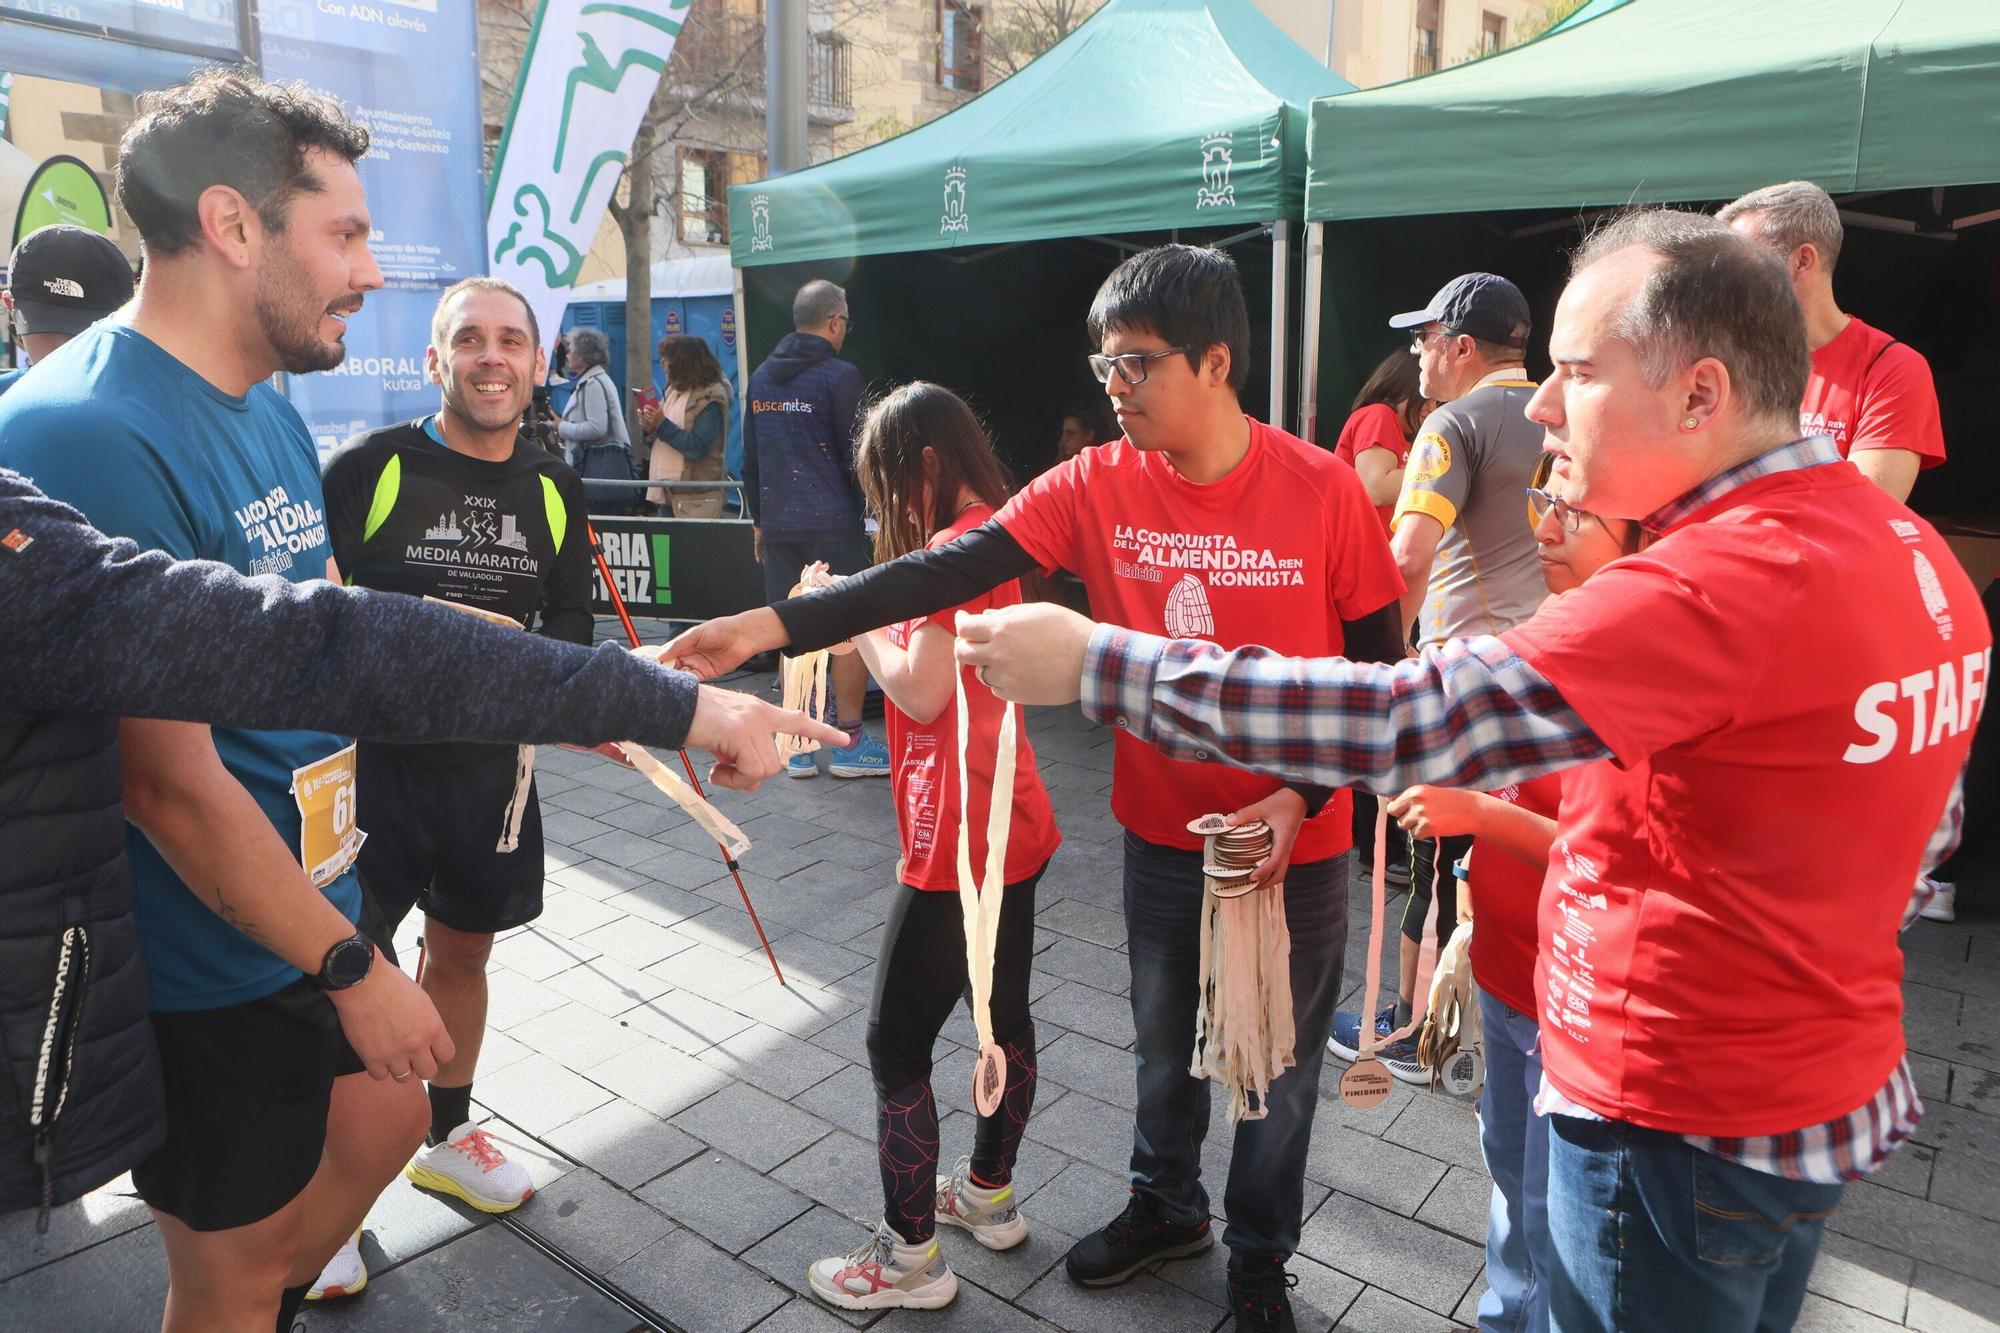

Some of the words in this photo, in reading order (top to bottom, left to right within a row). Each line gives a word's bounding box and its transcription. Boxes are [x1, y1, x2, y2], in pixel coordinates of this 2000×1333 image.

[317, 0, 346, 17] Con
[350, 4, 383, 24] ADN
[387, 11, 428, 33] alavés
[355, 104, 433, 126] Ayuntamiento
[372, 120, 452, 140] Vitoria-Gasteiz
[360, 147, 390, 160] dala
[43, 280, 70, 291] NORTH
[55, 277, 71, 286] THE
[50, 287, 71, 296] FACE
[382, 378, 421, 391] kutxa
[753, 398, 812, 415] Buscametas
[1827, 420, 1846, 429] REN
[464, 494, 498, 509] XXIX
[1115, 524, 1134, 540] LA
[1136, 528, 1237, 550] CONQUISTA
[592, 532, 651, 568] RIA
[1113, 539, 1128, 548] DE
[1129, 542, 1140, 551] LA
[1137, 545, 1277, 570] ALMENDRA
[1278, 558, 1303, 569] REN
[406, 544, 461, 563] MEDIA
[465, 552, 538, 573] MARATÓN
[448, 569, 458, 577] DE
[459, 571, 503, 582] VALLADOLID
[1122, 561, 1163, 583] Edición
[1208, 571, 1305, 587] KONKISTA
[592, 568, 652, 604] TEIZ
[858, 754, 884, 764] HOKA
[1345, 1087, 1388, 1097] FINISHER
